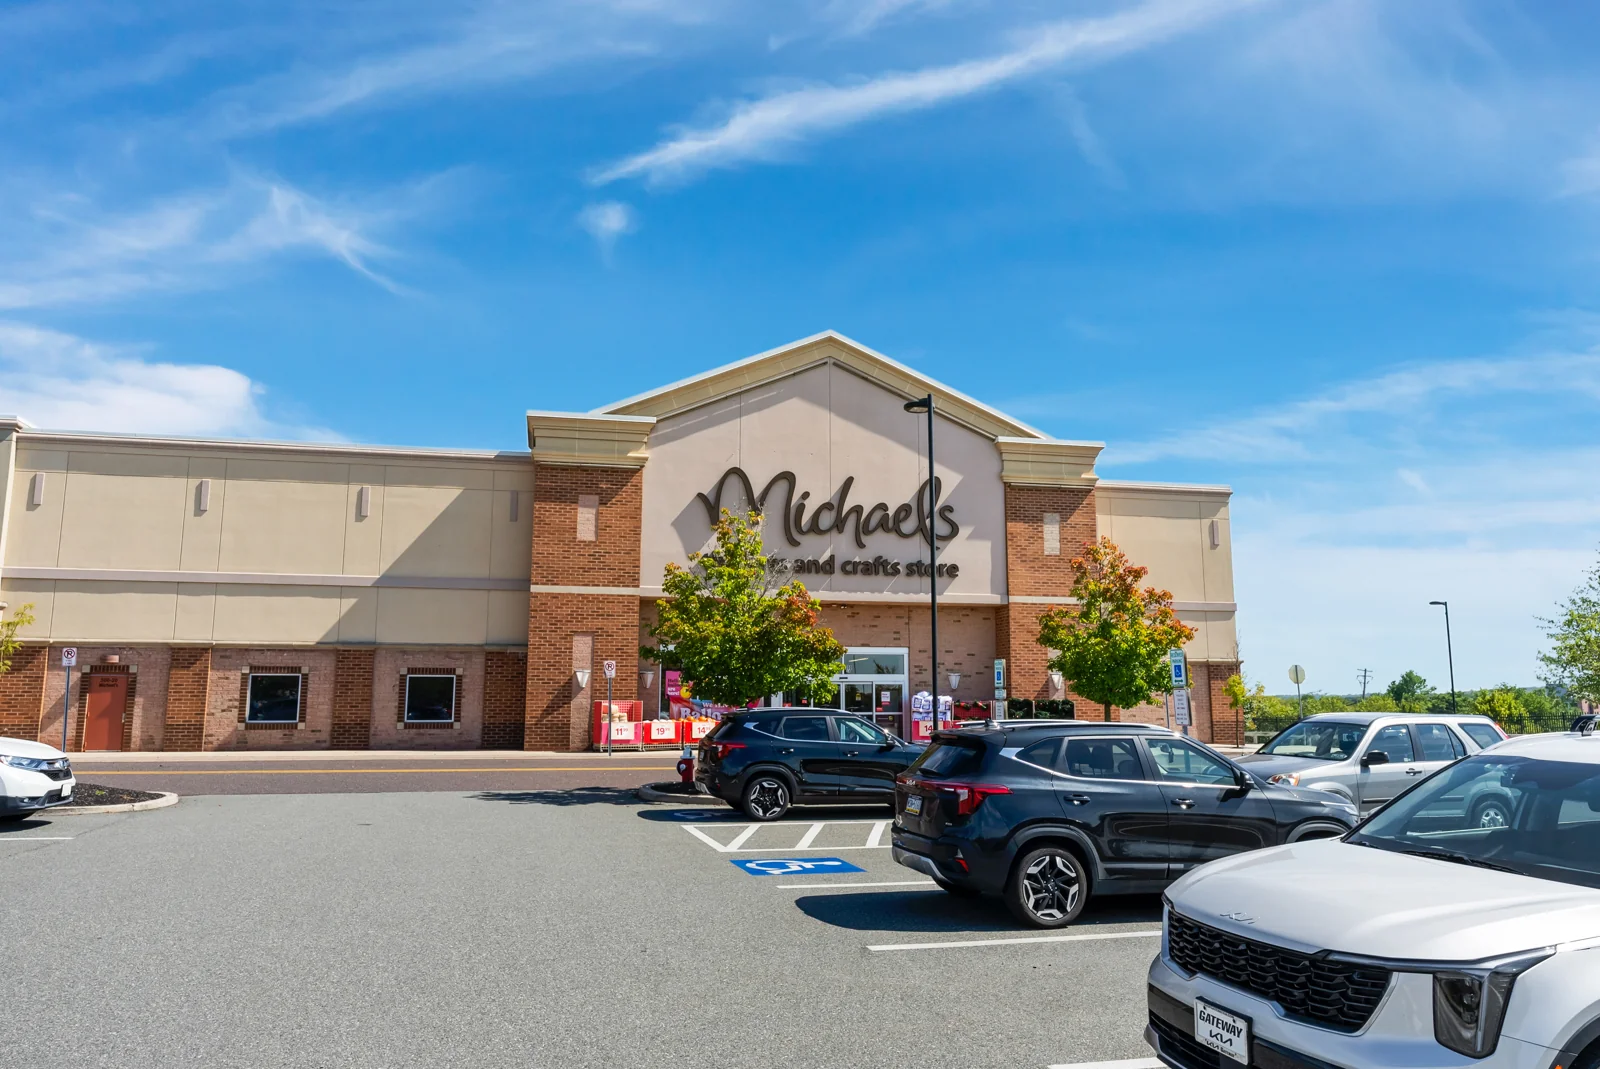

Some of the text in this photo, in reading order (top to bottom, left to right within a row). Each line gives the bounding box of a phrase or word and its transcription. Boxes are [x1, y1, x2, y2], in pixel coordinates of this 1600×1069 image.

[696, 466, 960, 550] Michaels
[794, 554, 836, 575] and
[840, 555, 902, 577] crafts
[905, 559, 960, 578] store
[680, 706, 723, 720] Ballo
[1198, 1009, 1243, 1039] GATEWAY
[1209, 1029, 1233, 1047] KIA
